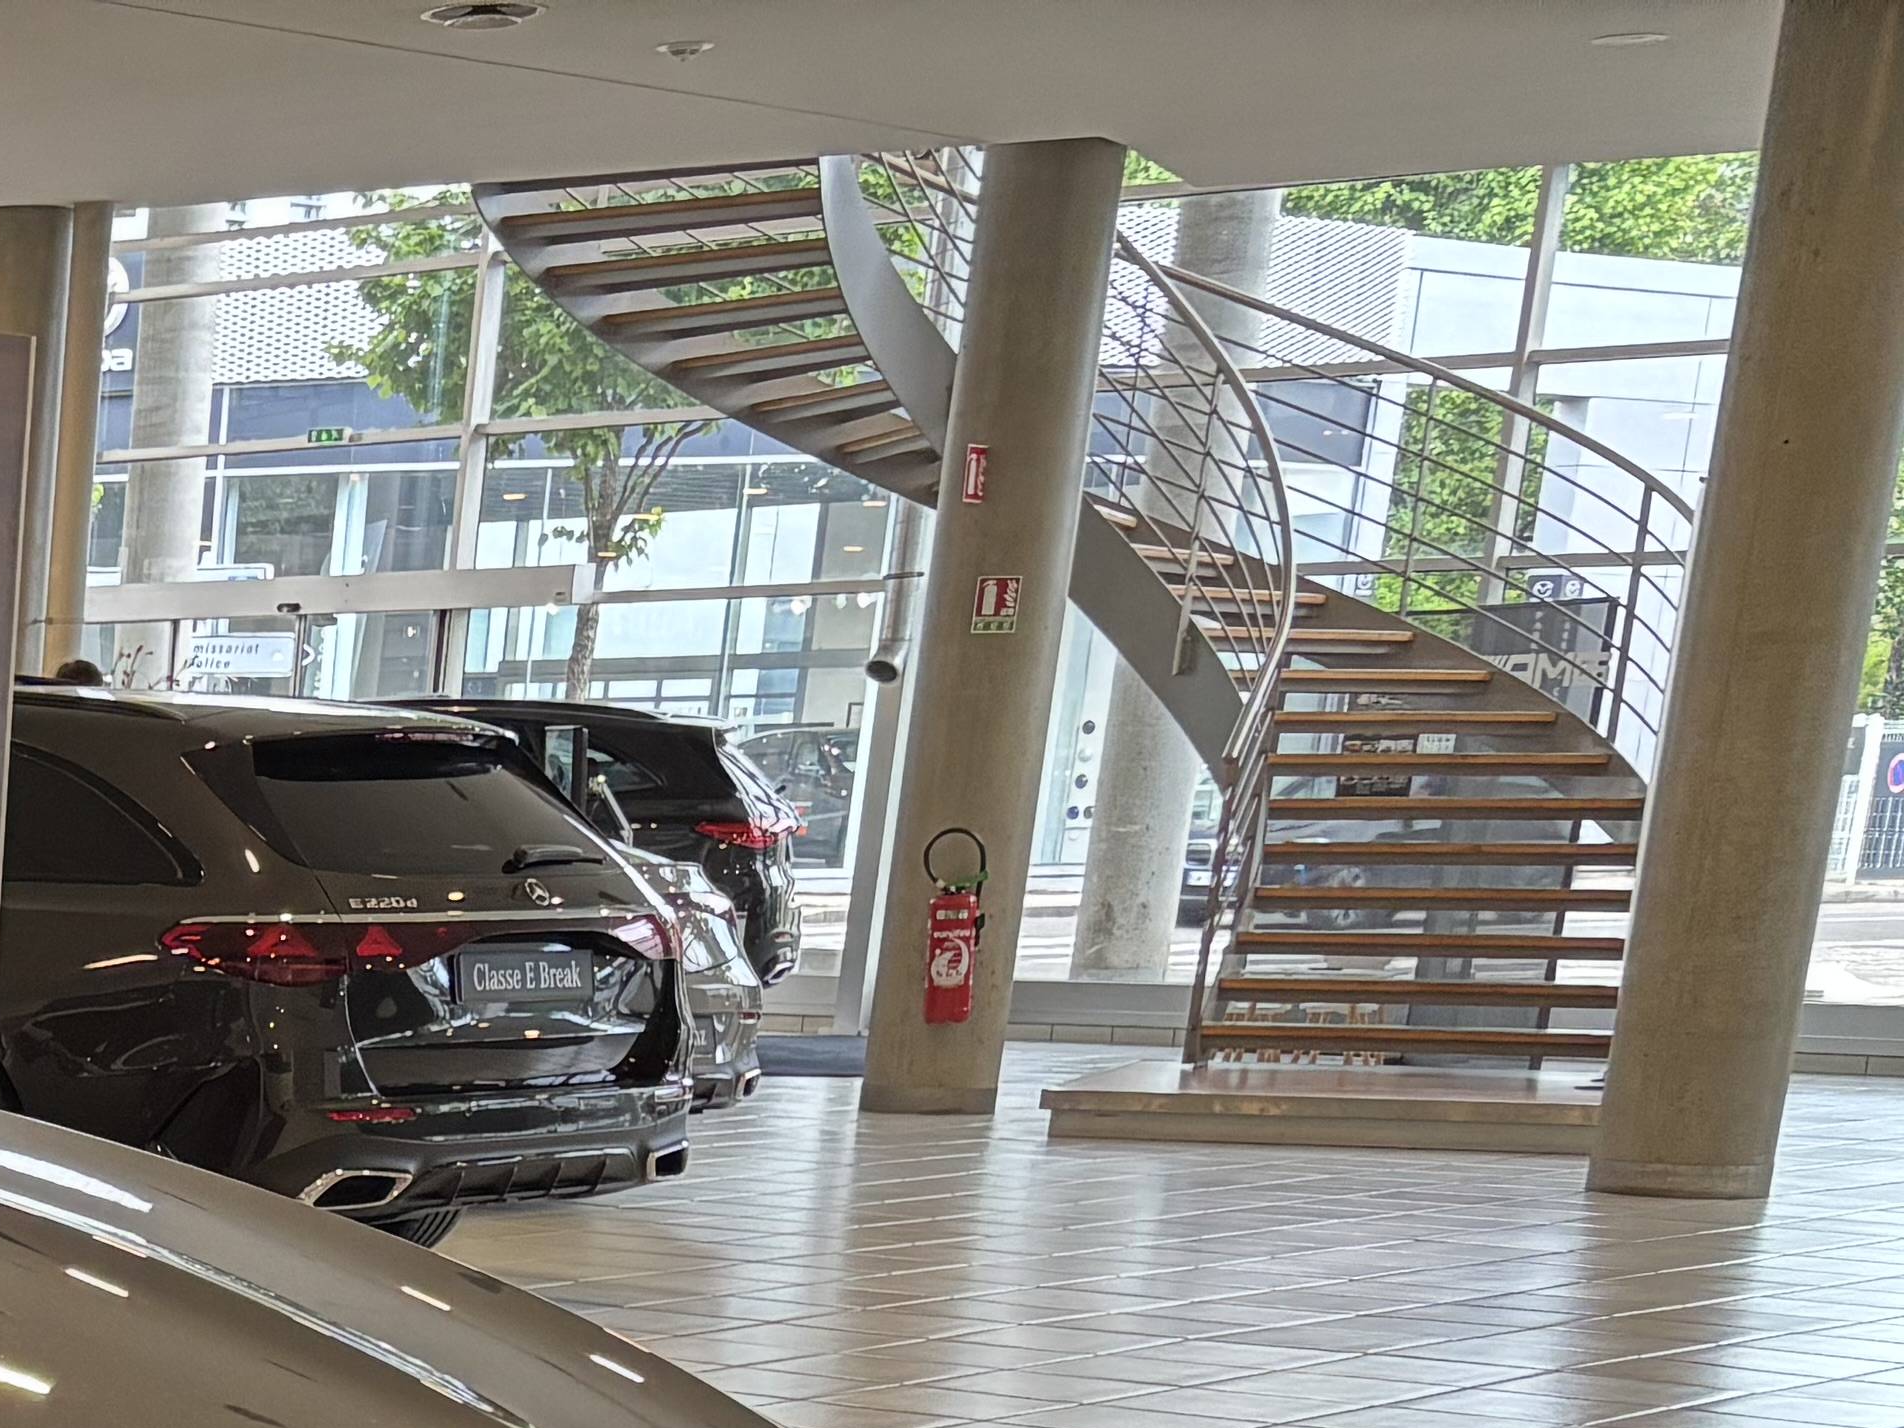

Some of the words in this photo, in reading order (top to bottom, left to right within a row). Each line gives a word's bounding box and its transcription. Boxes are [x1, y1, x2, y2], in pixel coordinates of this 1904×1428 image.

[473, 963, 521, 990] Classe
[525, 962, 535, 989] E
[539, 960, 581, 989] Break
